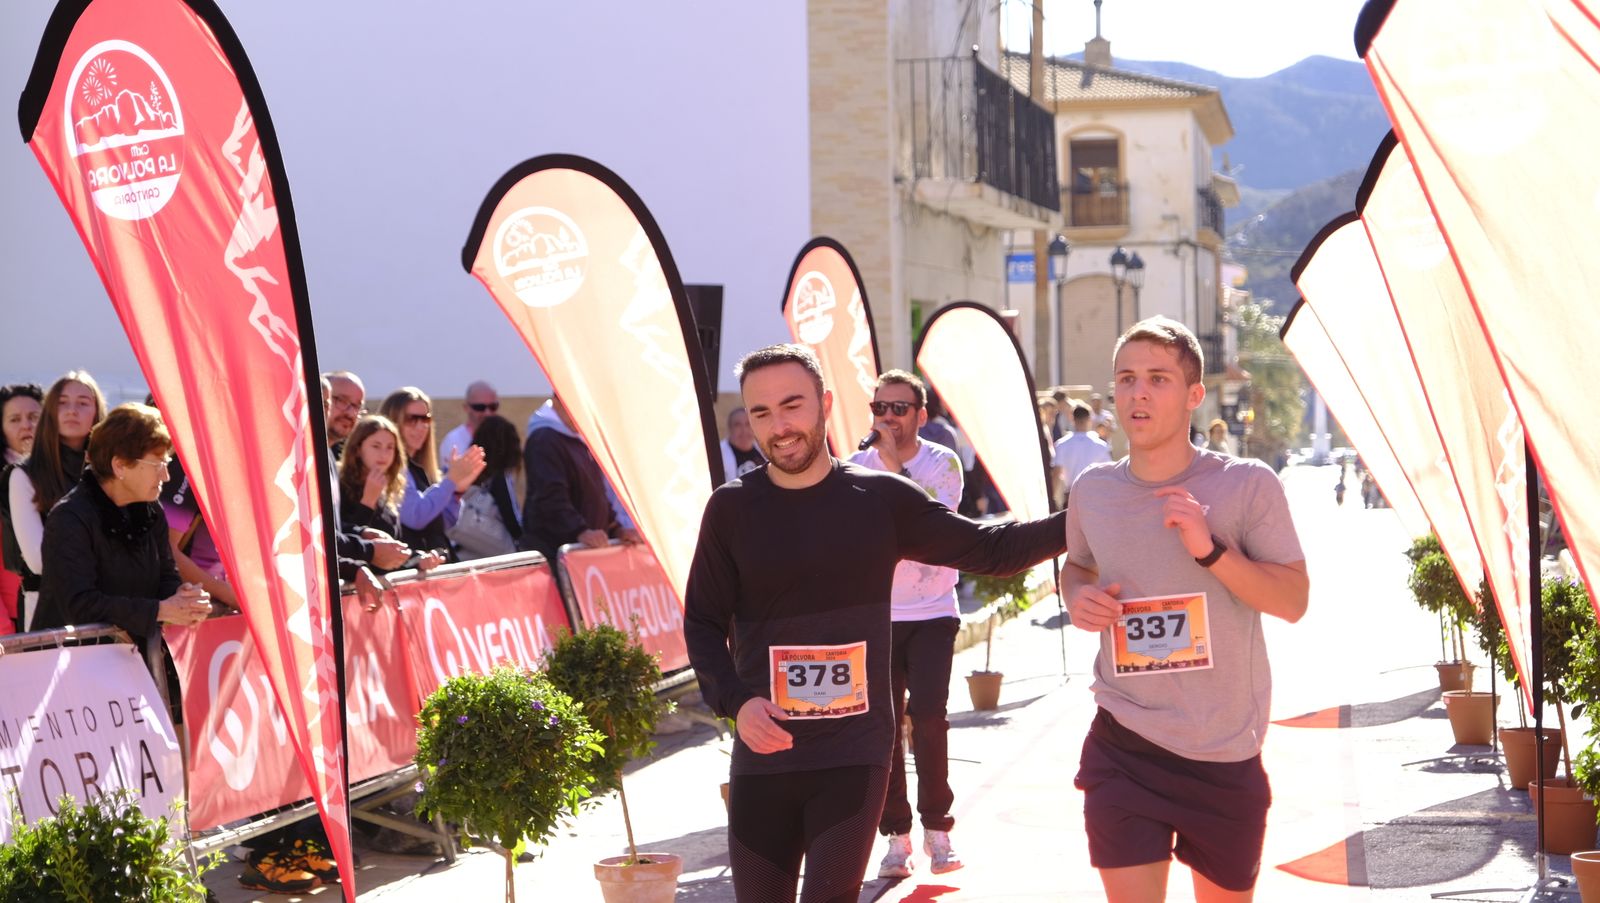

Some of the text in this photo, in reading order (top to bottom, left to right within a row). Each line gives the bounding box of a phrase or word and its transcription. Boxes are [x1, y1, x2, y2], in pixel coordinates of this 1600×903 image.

[1127, 613, 1186, 641] 337
[788, 663, 850, 687] 378
[108, 697, 145, 729] DE
